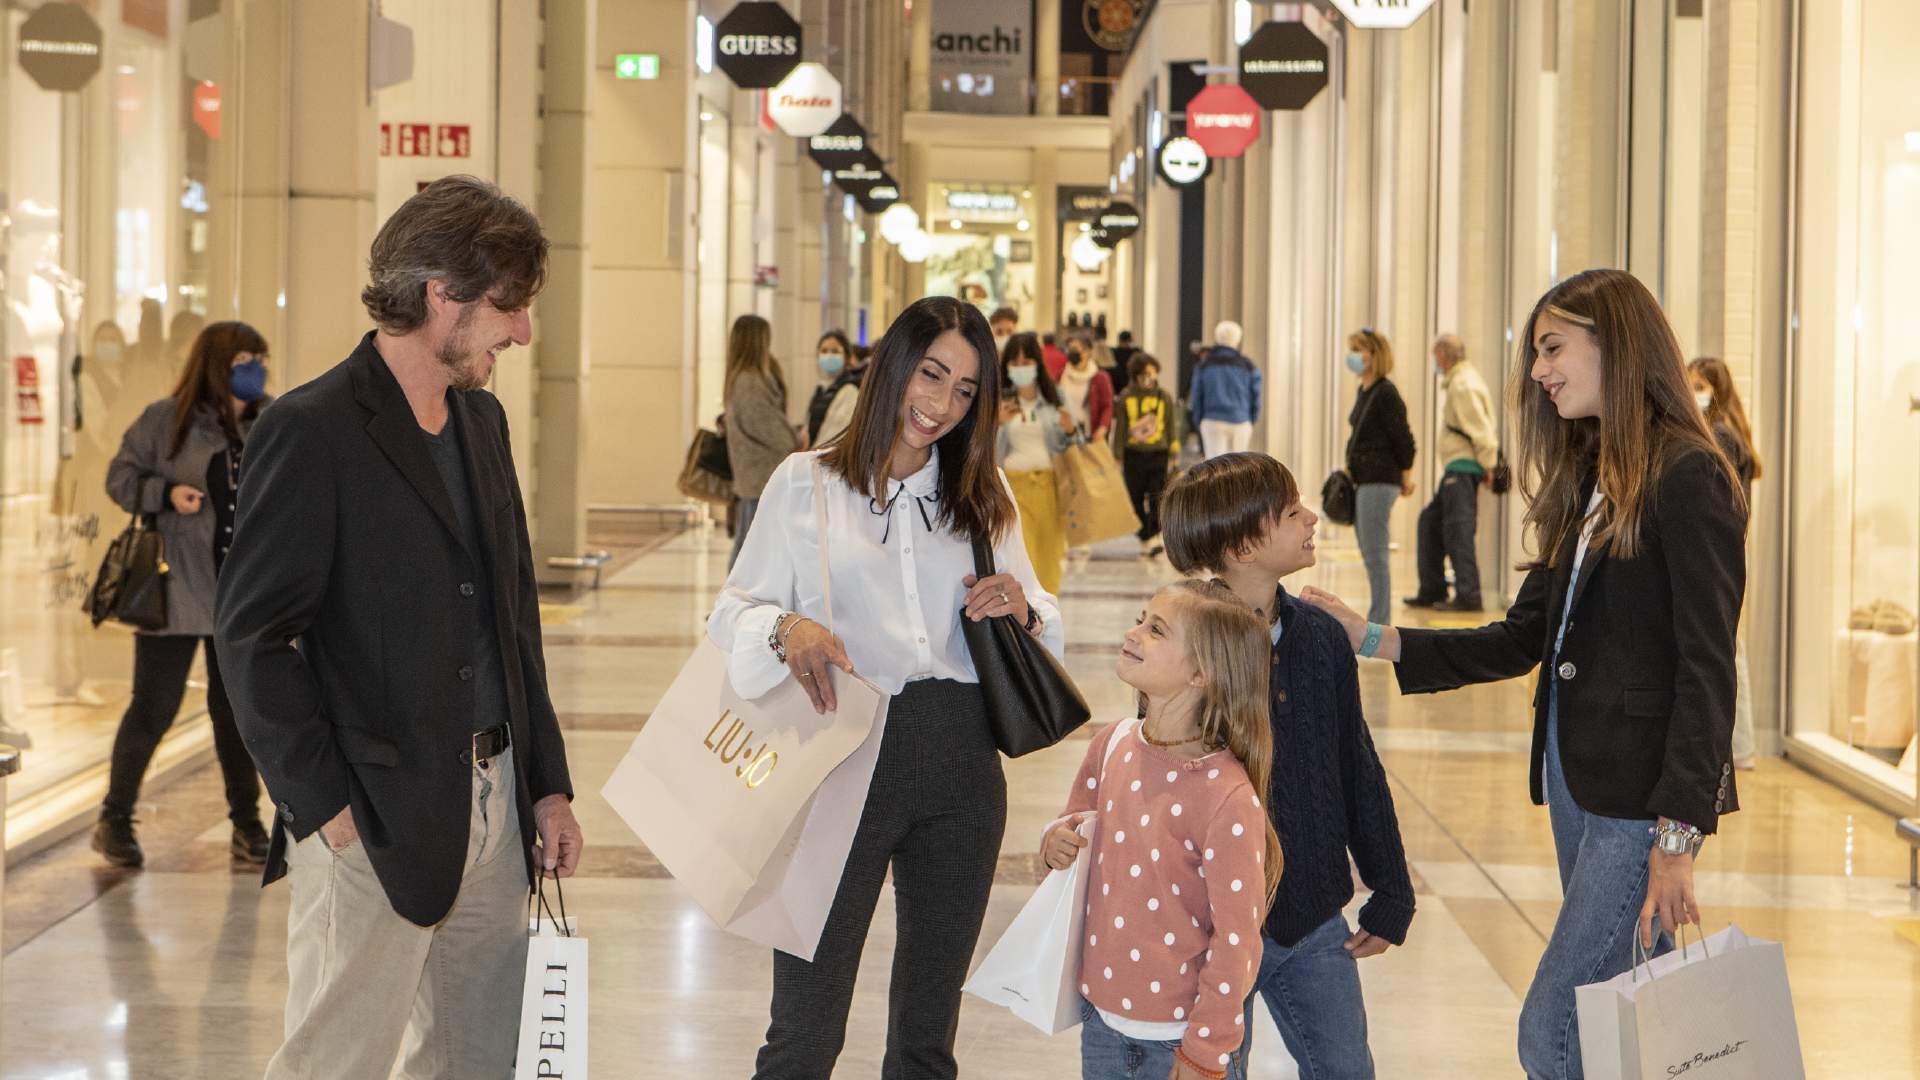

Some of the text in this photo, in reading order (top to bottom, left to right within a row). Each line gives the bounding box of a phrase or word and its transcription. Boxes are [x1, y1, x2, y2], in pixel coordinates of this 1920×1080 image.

[719, 34, 798, 56] GUESS
[930, 26, 1022, 53] anchi
[1692, 1040, 1750, 1067] Benedict
